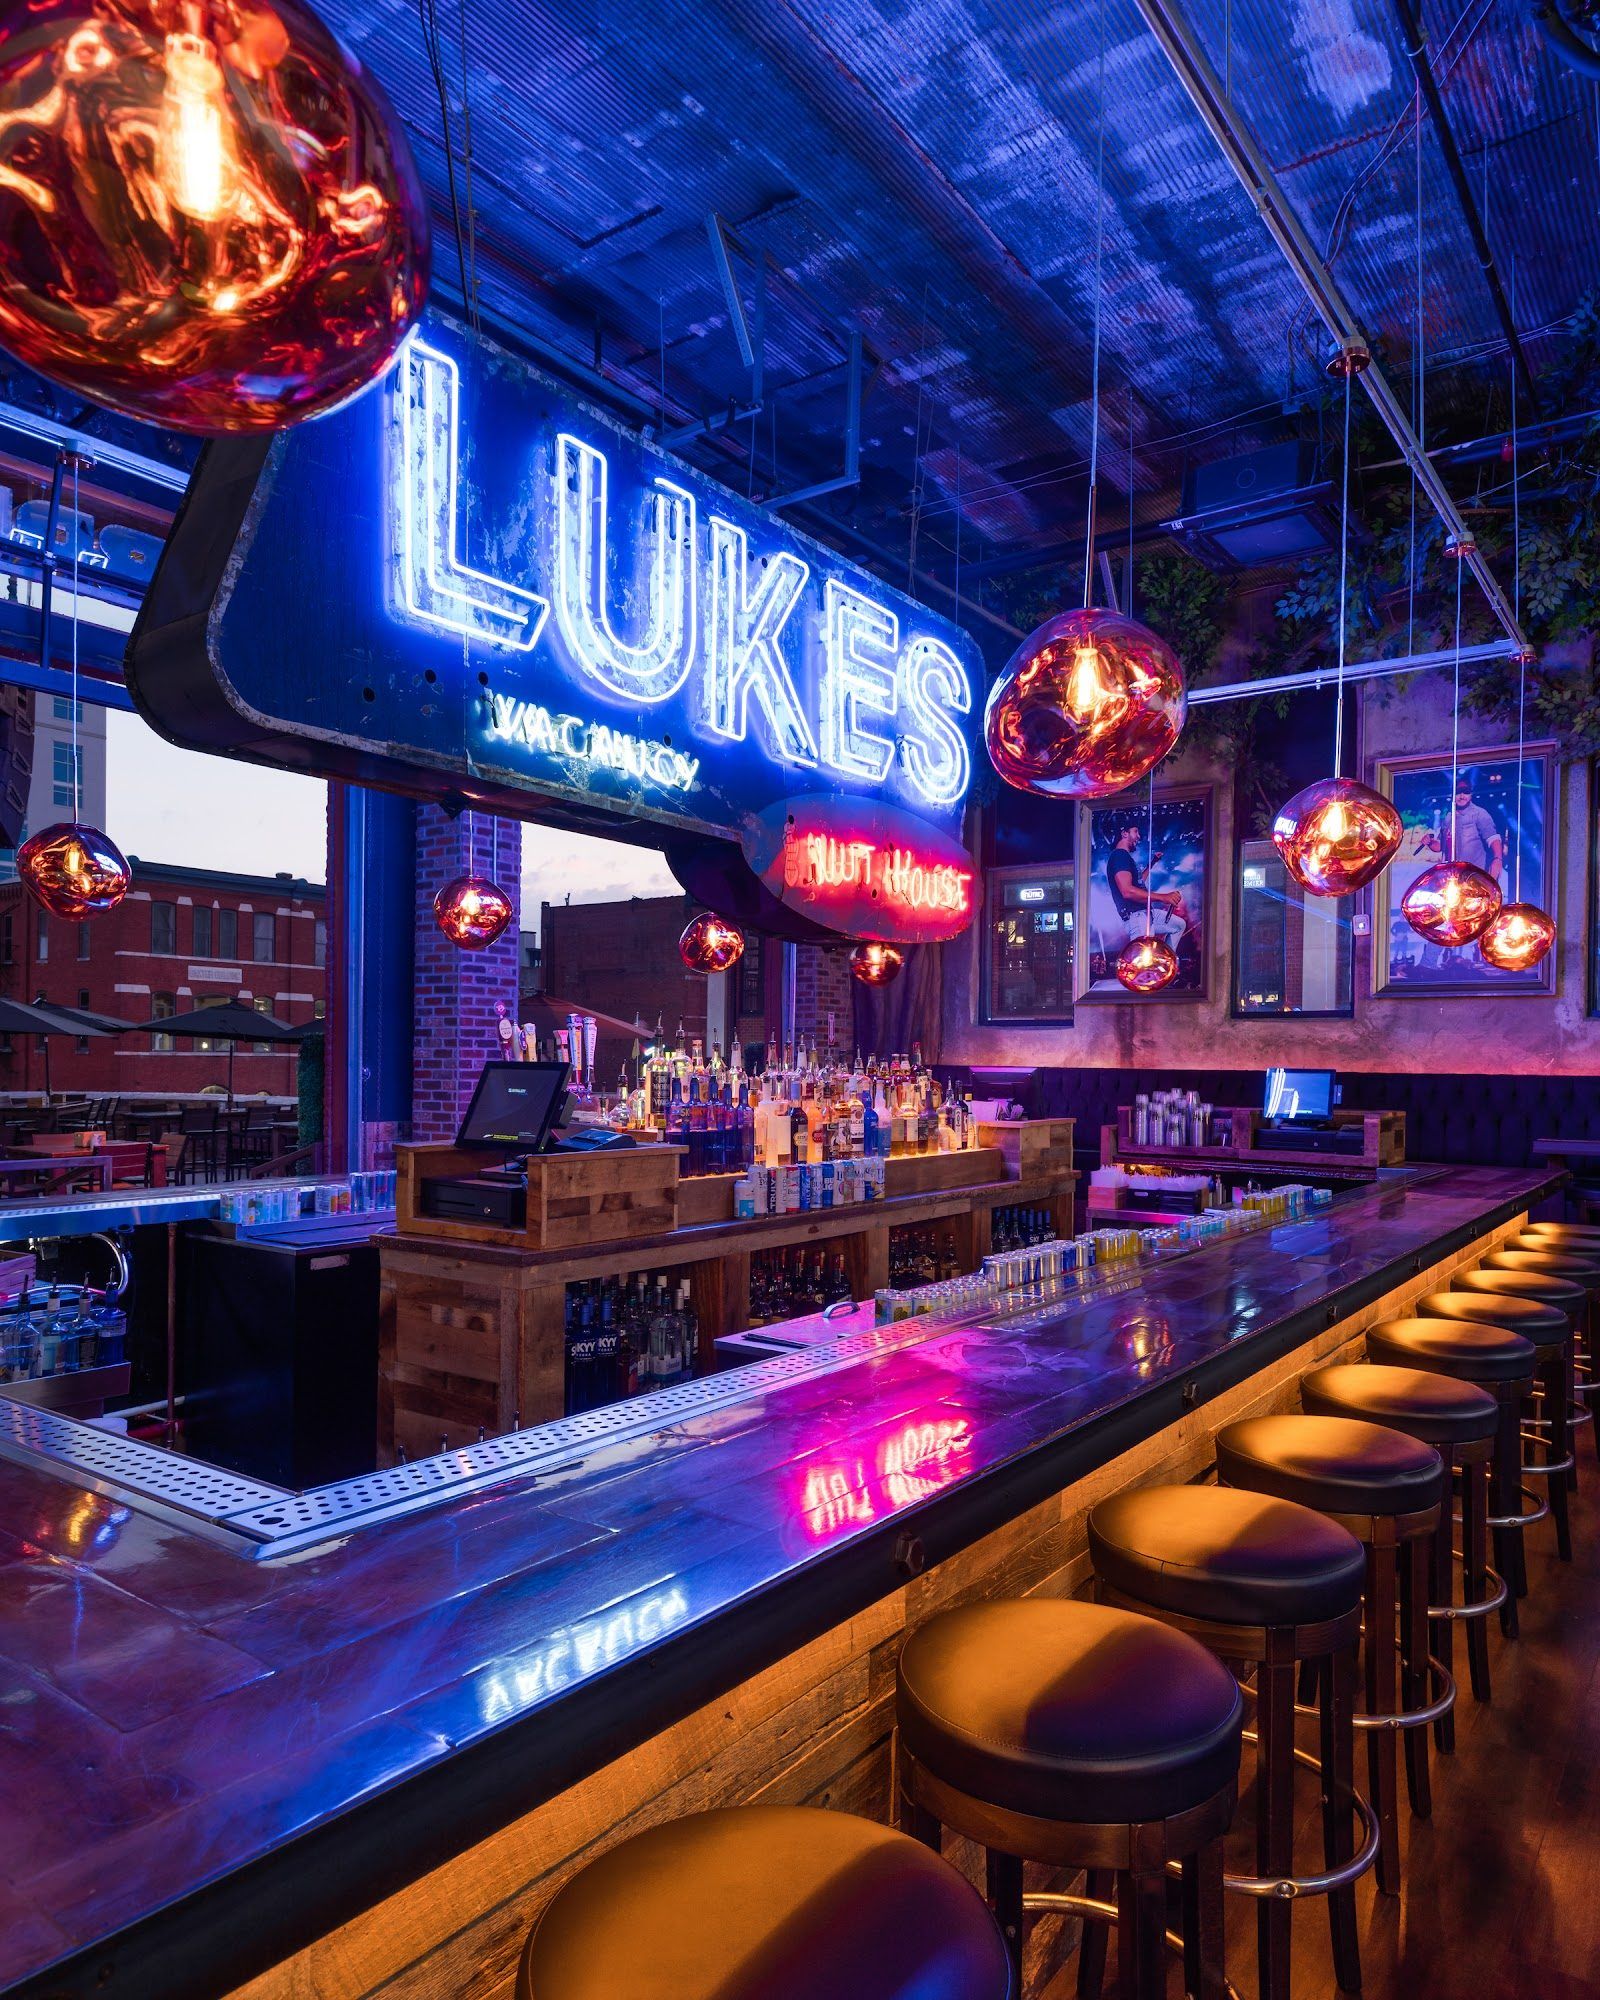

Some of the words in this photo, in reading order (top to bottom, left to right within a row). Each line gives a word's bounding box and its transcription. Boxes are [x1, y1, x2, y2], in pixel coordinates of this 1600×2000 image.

[391, 337, 973, 805] LUKES
[488, 691, 700, 791] VACANCY
[806, 832, 876, 887] NUT
[884, 848, 972, 911] HOUSE
[598, 1336, 617, 1347] KYY
